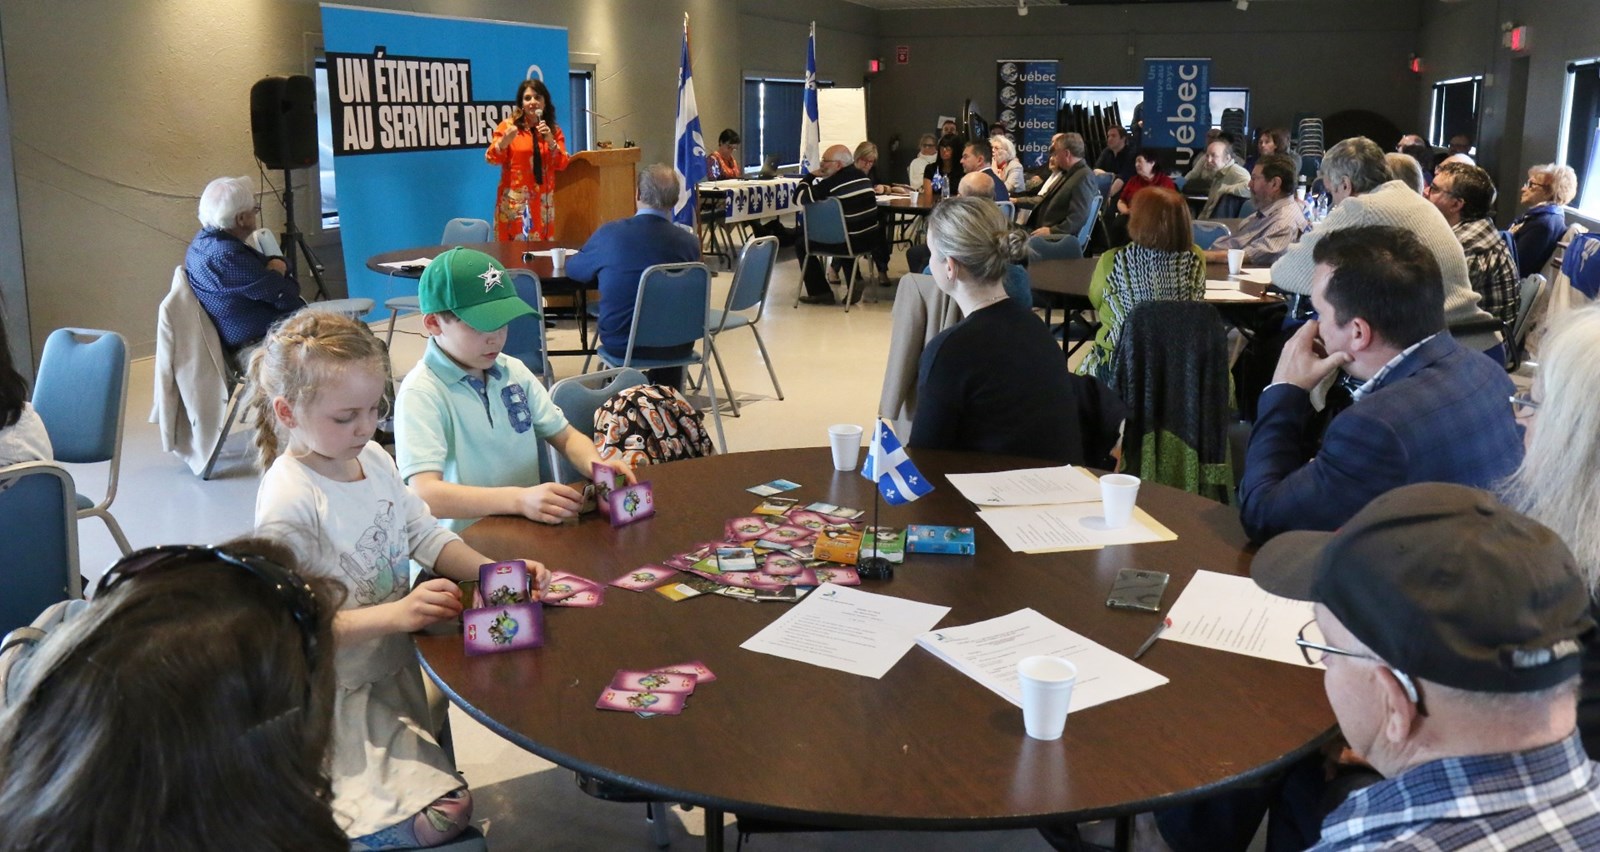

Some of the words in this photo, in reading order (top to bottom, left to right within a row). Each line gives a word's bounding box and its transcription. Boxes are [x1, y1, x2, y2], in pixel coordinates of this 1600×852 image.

[336, 57, 371, 103] UN
[343, 105, 375, 150] AU
[379, 105, 460, 149] SERVICE
[464, 104, 498, 145] DES
